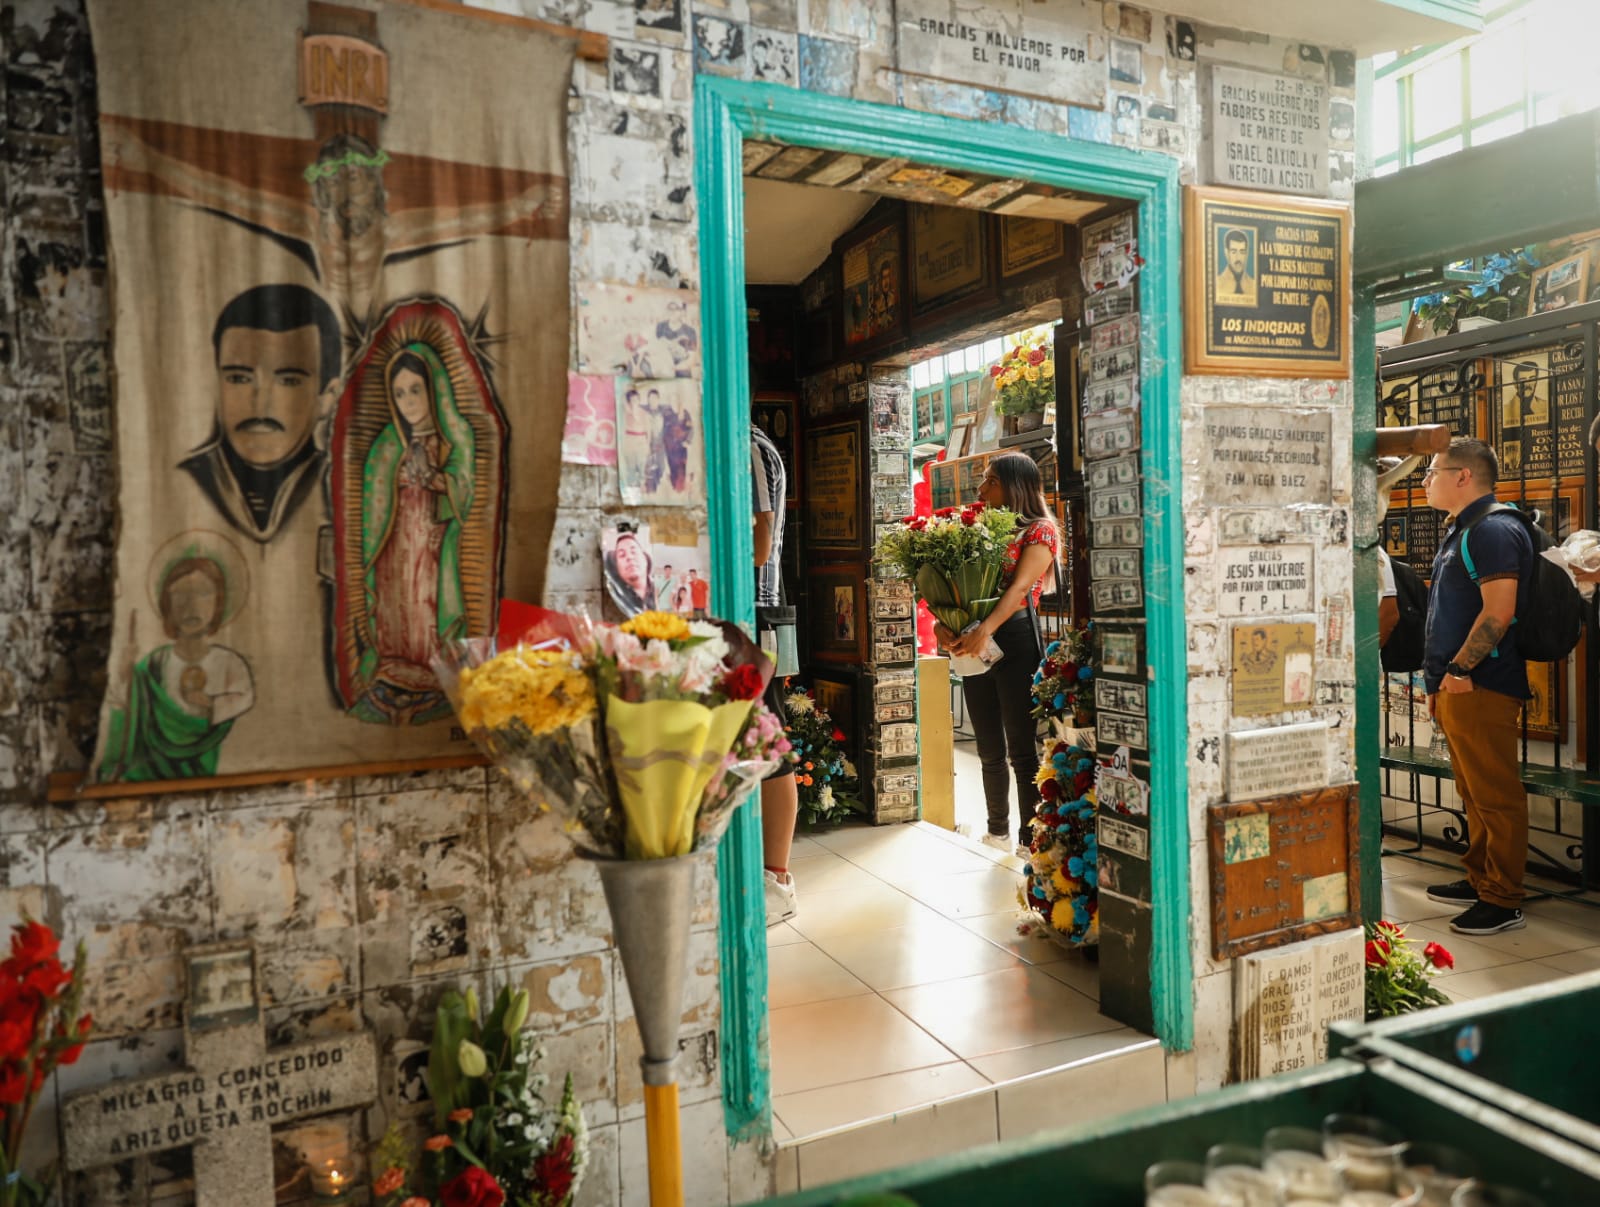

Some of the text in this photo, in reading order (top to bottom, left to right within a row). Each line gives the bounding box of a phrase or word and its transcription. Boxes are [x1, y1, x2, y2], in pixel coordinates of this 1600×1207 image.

[919, 17, 1086, 64] GRACIAS MALVERDE POR
[972, 46, 1041, 73] EL FAVOR
[311, 44, 385, 108] INRI
[1221, 84, 1320, 113] GRACIAS MALVERDE POR
[1220, 101, 1321, 131] FABORES RESIVIDOS
[1240, 122, 1304, 145] DE PARTE DE
[1226, 142, 1318, 170] ISRAEL GAXIOLA Y
[1278, 168, 1316, 190] ACOSTA
[1265, 241, 1273, 256] LA
[1280, 259, 1297, 274] JESUS
[1298, 277, 1309, 291] LOS
[1273, 291, 1281, 305] DE
[1281, 291, 1300, 306] PARTE
[1221, 318, 1306, 336] LOS INDIGENAS
[1206, 425, 1326, 443] TE DAMOS GRACIAS MALVERDE
[1213, 448, 1230, 461] POR
[1232, 449, 1271, 463] FAVORES
[1252, 473, 1276, 487] VEGA
[1281, 474, 1306, 488] BAEZ
[1249, 550, 1282, 562] GRACIAS
[1226, 562, 1305, 579] JESUS MALVERDE
[1222, 578, 1307, 593] POR FAVOR CONCEDIDO
[1332, 951, 1350, 967] POR
[1279, 962, 1312, 981] DAMOS
[1262, 980, 1306, 1000] GRACIAS
[1319, 981, 1356, 1000] MILAGRO
[1262, 999, 1286, 1015] DIOS
[1331, 996, 1350, 1012] FAM
[1264, 1011, 1303, 1029] VIRGEN
[1263, 1029, 1295, 1046] SANTO
[1296, 1041, 1302, 1053] A
[1271, 1055, 1306, 1074] JESUS
[102, 1047, 344, 1115] MILAGRO CONCEDIDO
[173, 1102, 186, 1120] A
[196, 1092, 230, 1116] LA
[250, 1088, 333, 1123] ROCHIN
